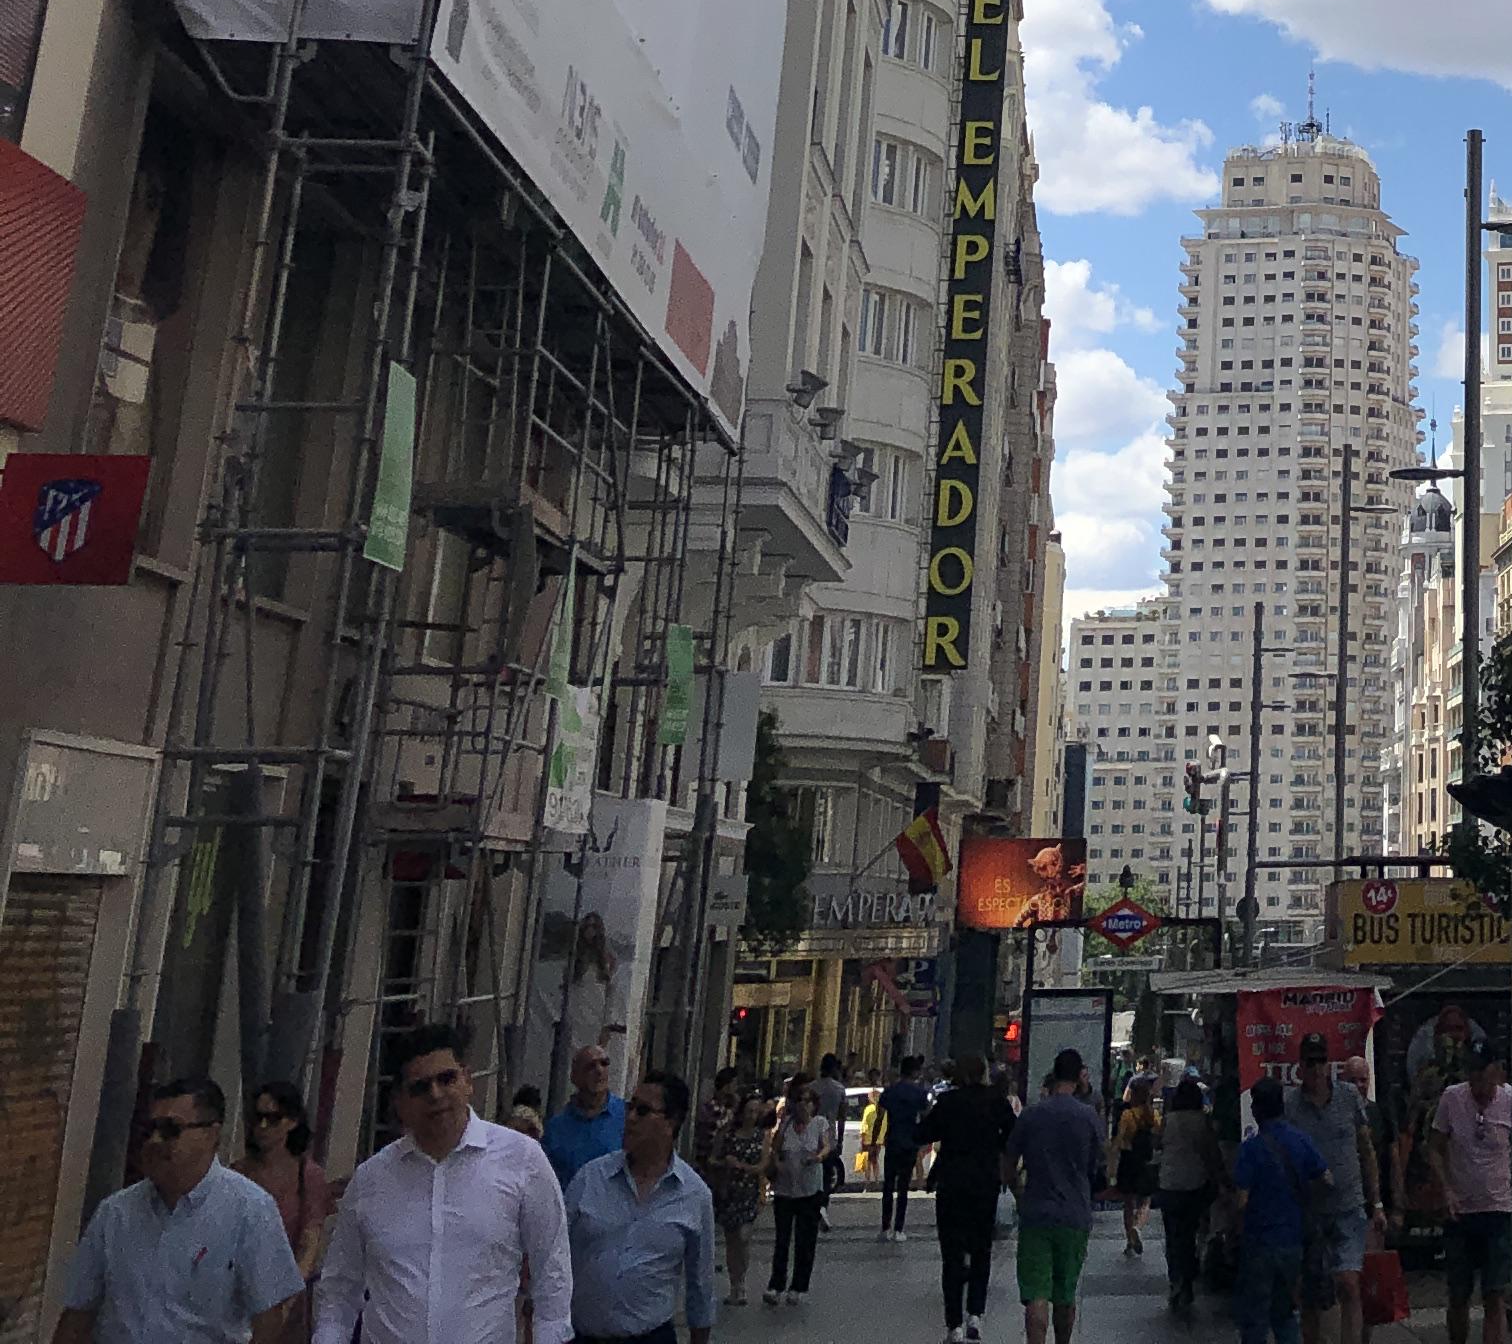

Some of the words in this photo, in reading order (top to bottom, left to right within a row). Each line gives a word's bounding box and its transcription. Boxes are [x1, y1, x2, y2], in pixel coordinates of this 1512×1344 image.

[925, 120, 996, 667] EMPERADOR
[994, 878, 1011, 893] ES
[1107, 917, 1141, 930] Metro
[1353, 912, 1399, 945] BUS
